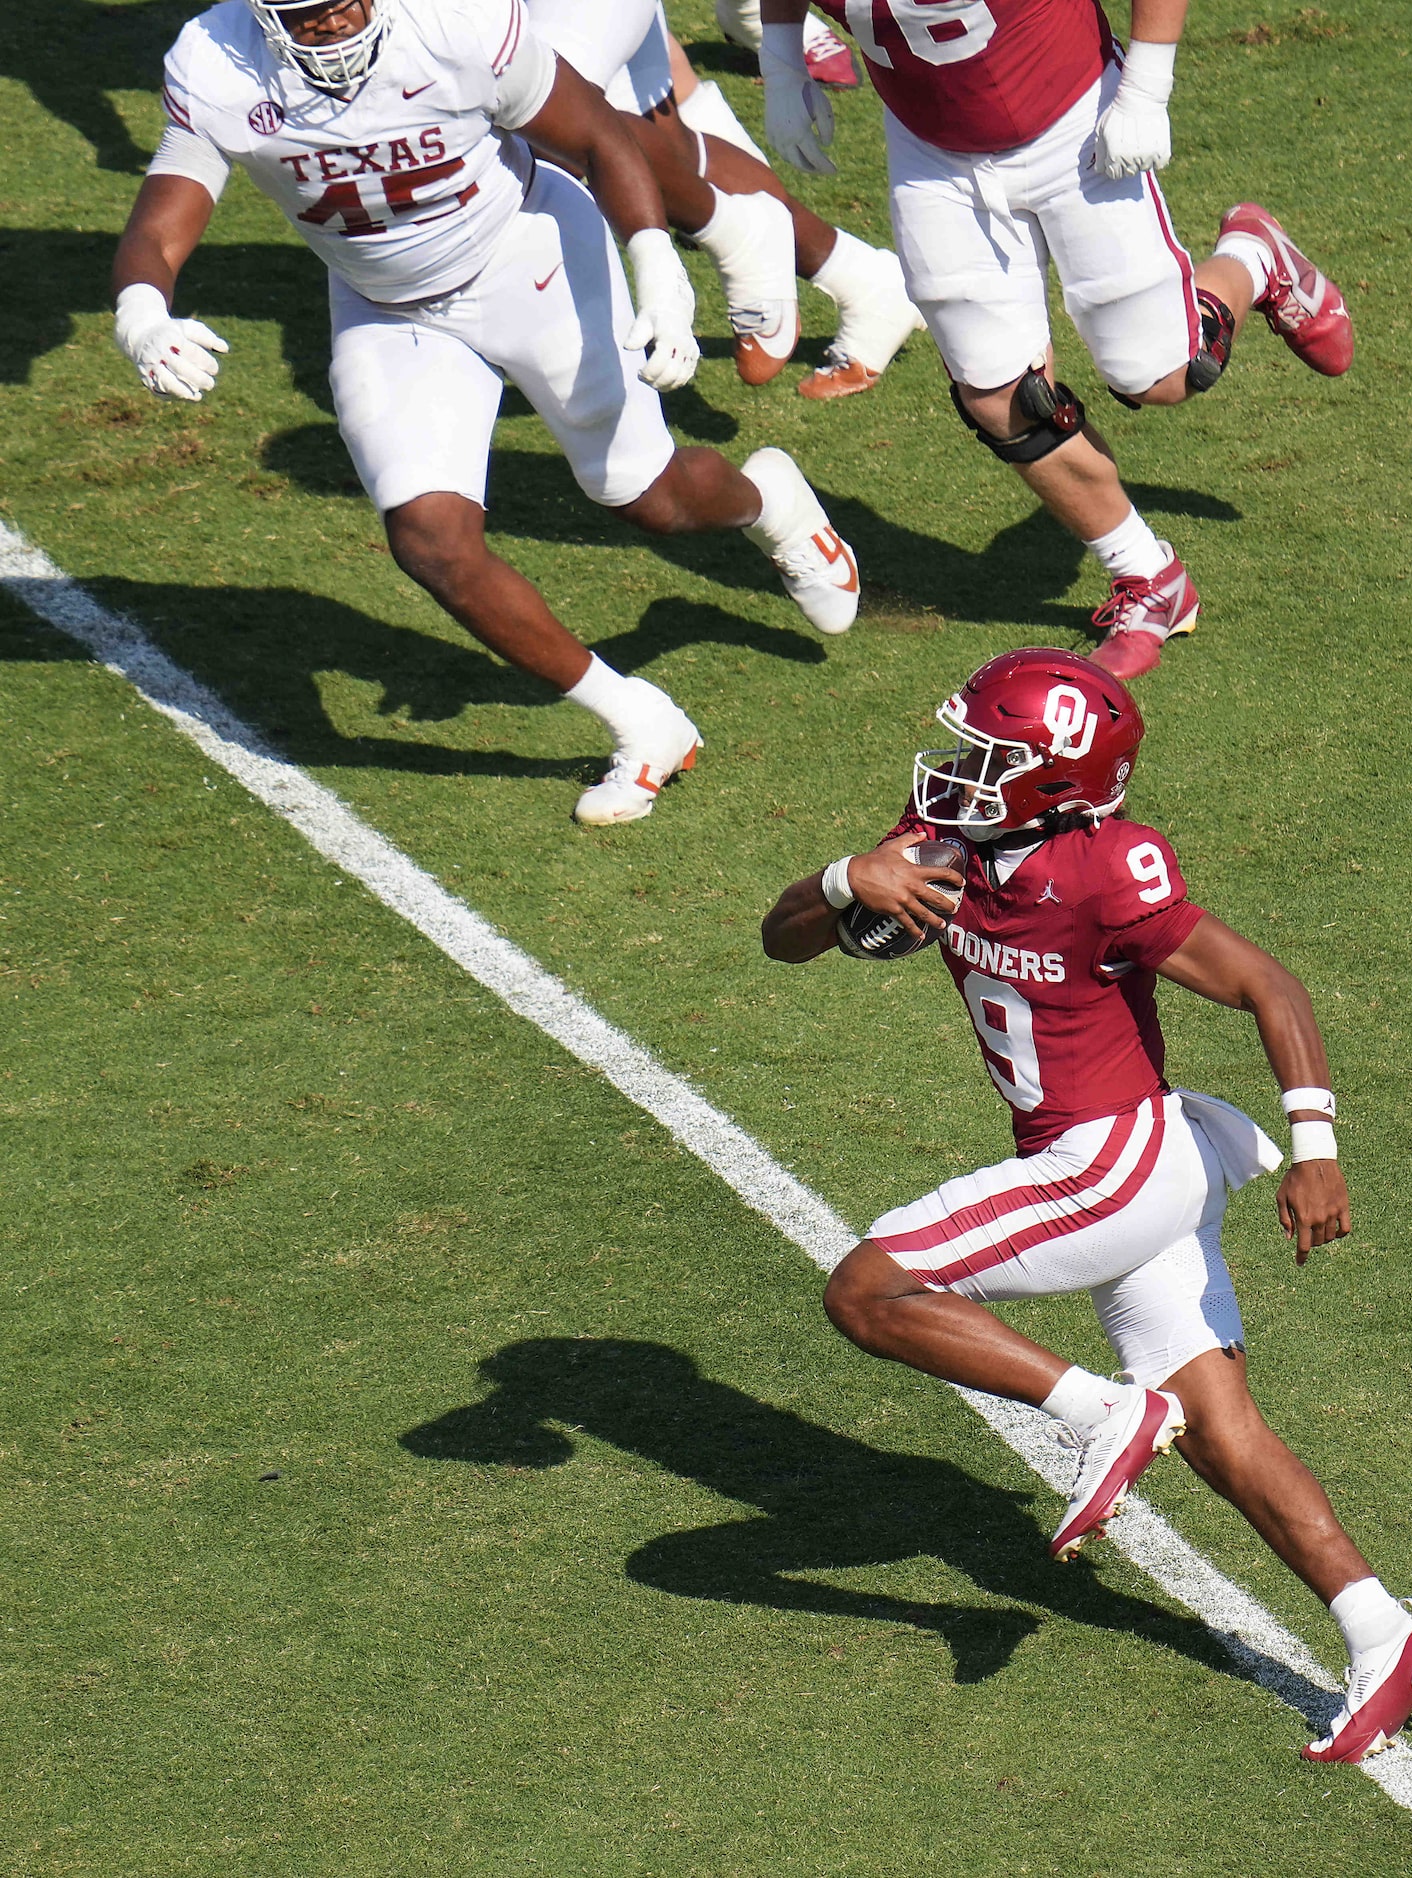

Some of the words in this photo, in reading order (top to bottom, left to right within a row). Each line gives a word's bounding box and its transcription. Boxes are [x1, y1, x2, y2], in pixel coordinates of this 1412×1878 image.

[250, 103, 284, 134] SEC
[280, 126, 447, 182] TEXAS
[297, 156, 480, 237] 45
[1126, 841, 1172, 904] 9
[940, 923, 1066, 983] OONERS
[963, 969, 1044, 1112] 9
